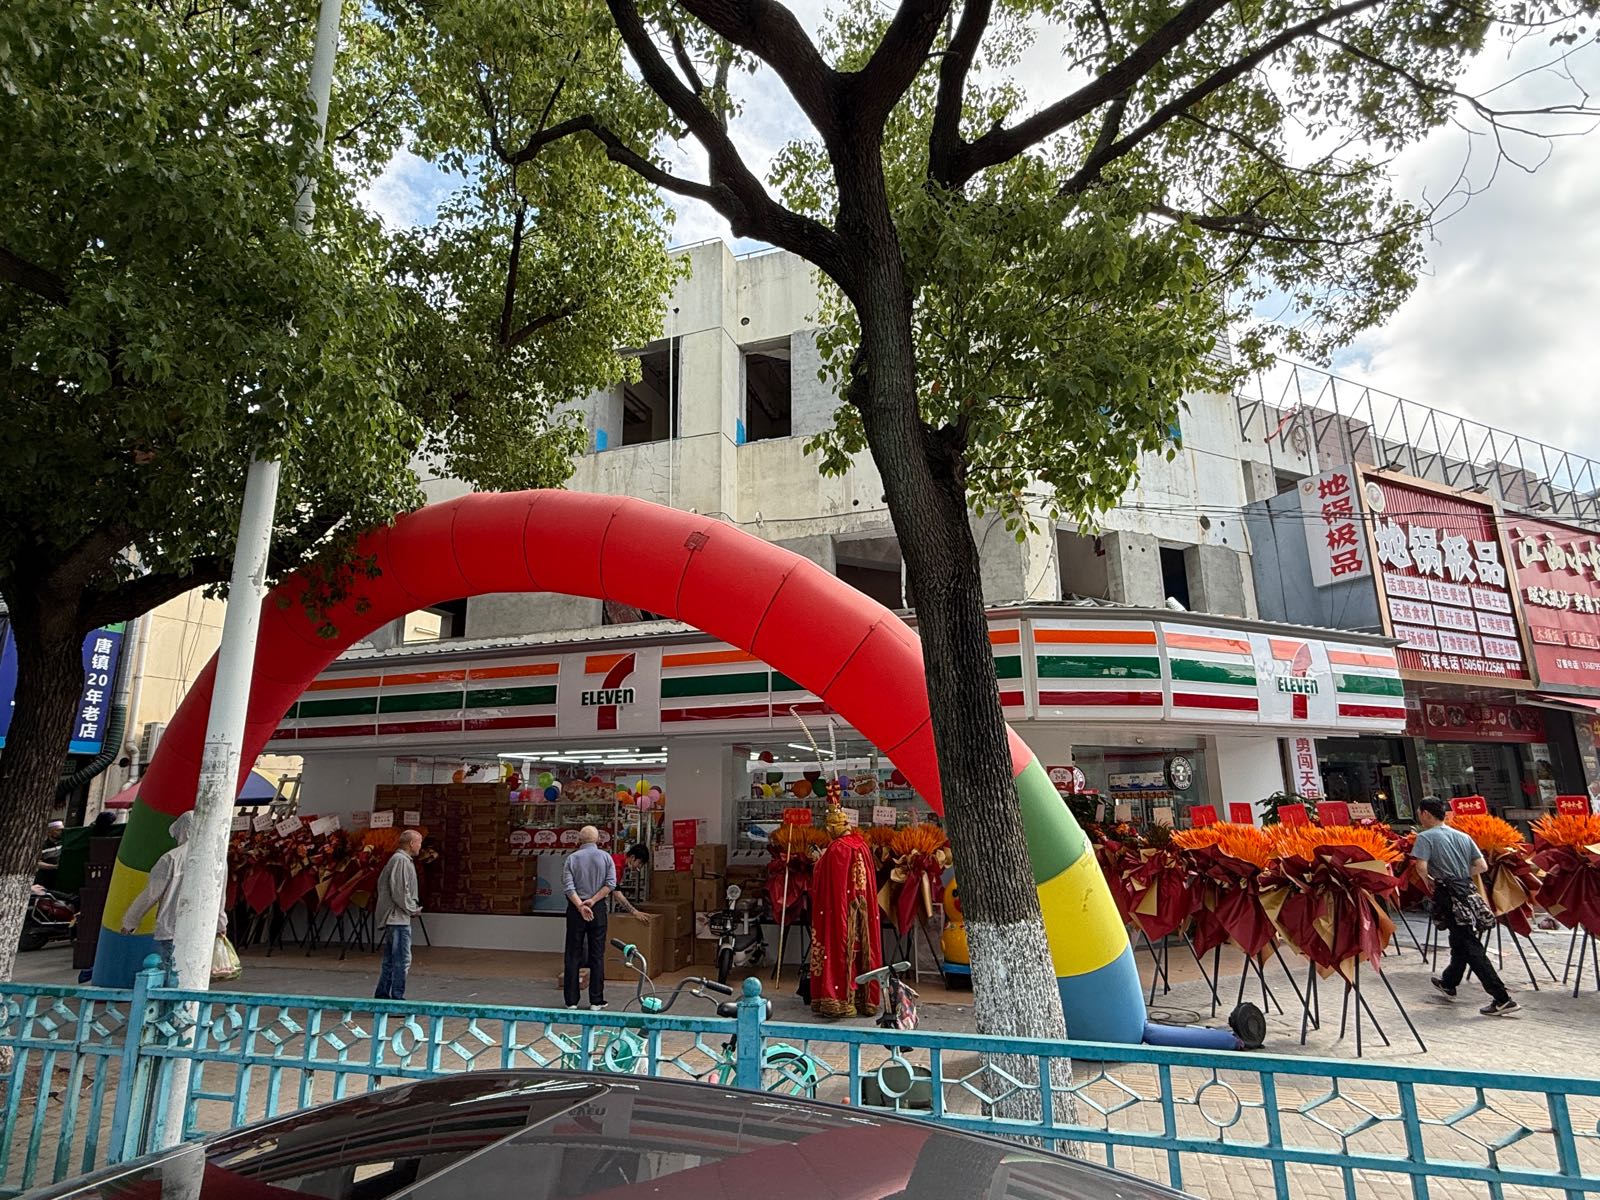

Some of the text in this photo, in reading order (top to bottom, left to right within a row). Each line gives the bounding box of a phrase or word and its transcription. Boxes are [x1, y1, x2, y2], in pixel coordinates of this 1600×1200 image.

[1318, 473, 1363, 577] 地锅极品
[1374, 516, 1505, 588] 地锅极品
[1387, 577, 1427, 596] 活鸡现杀
[1432, 584, 1468, 603] 特色餐饮
[1393, 602, 1430, 621] 天然食材
[1437, 609, 1473, 627] 原汁原味
[1421, 652, 1459, 670] 订餐电话
[78, 637, 113, 739] 唐镇20年老店
[581, 688, 635, 706] ELEVEn
[1295, 737, 1319, 800] 勇闯天涯
